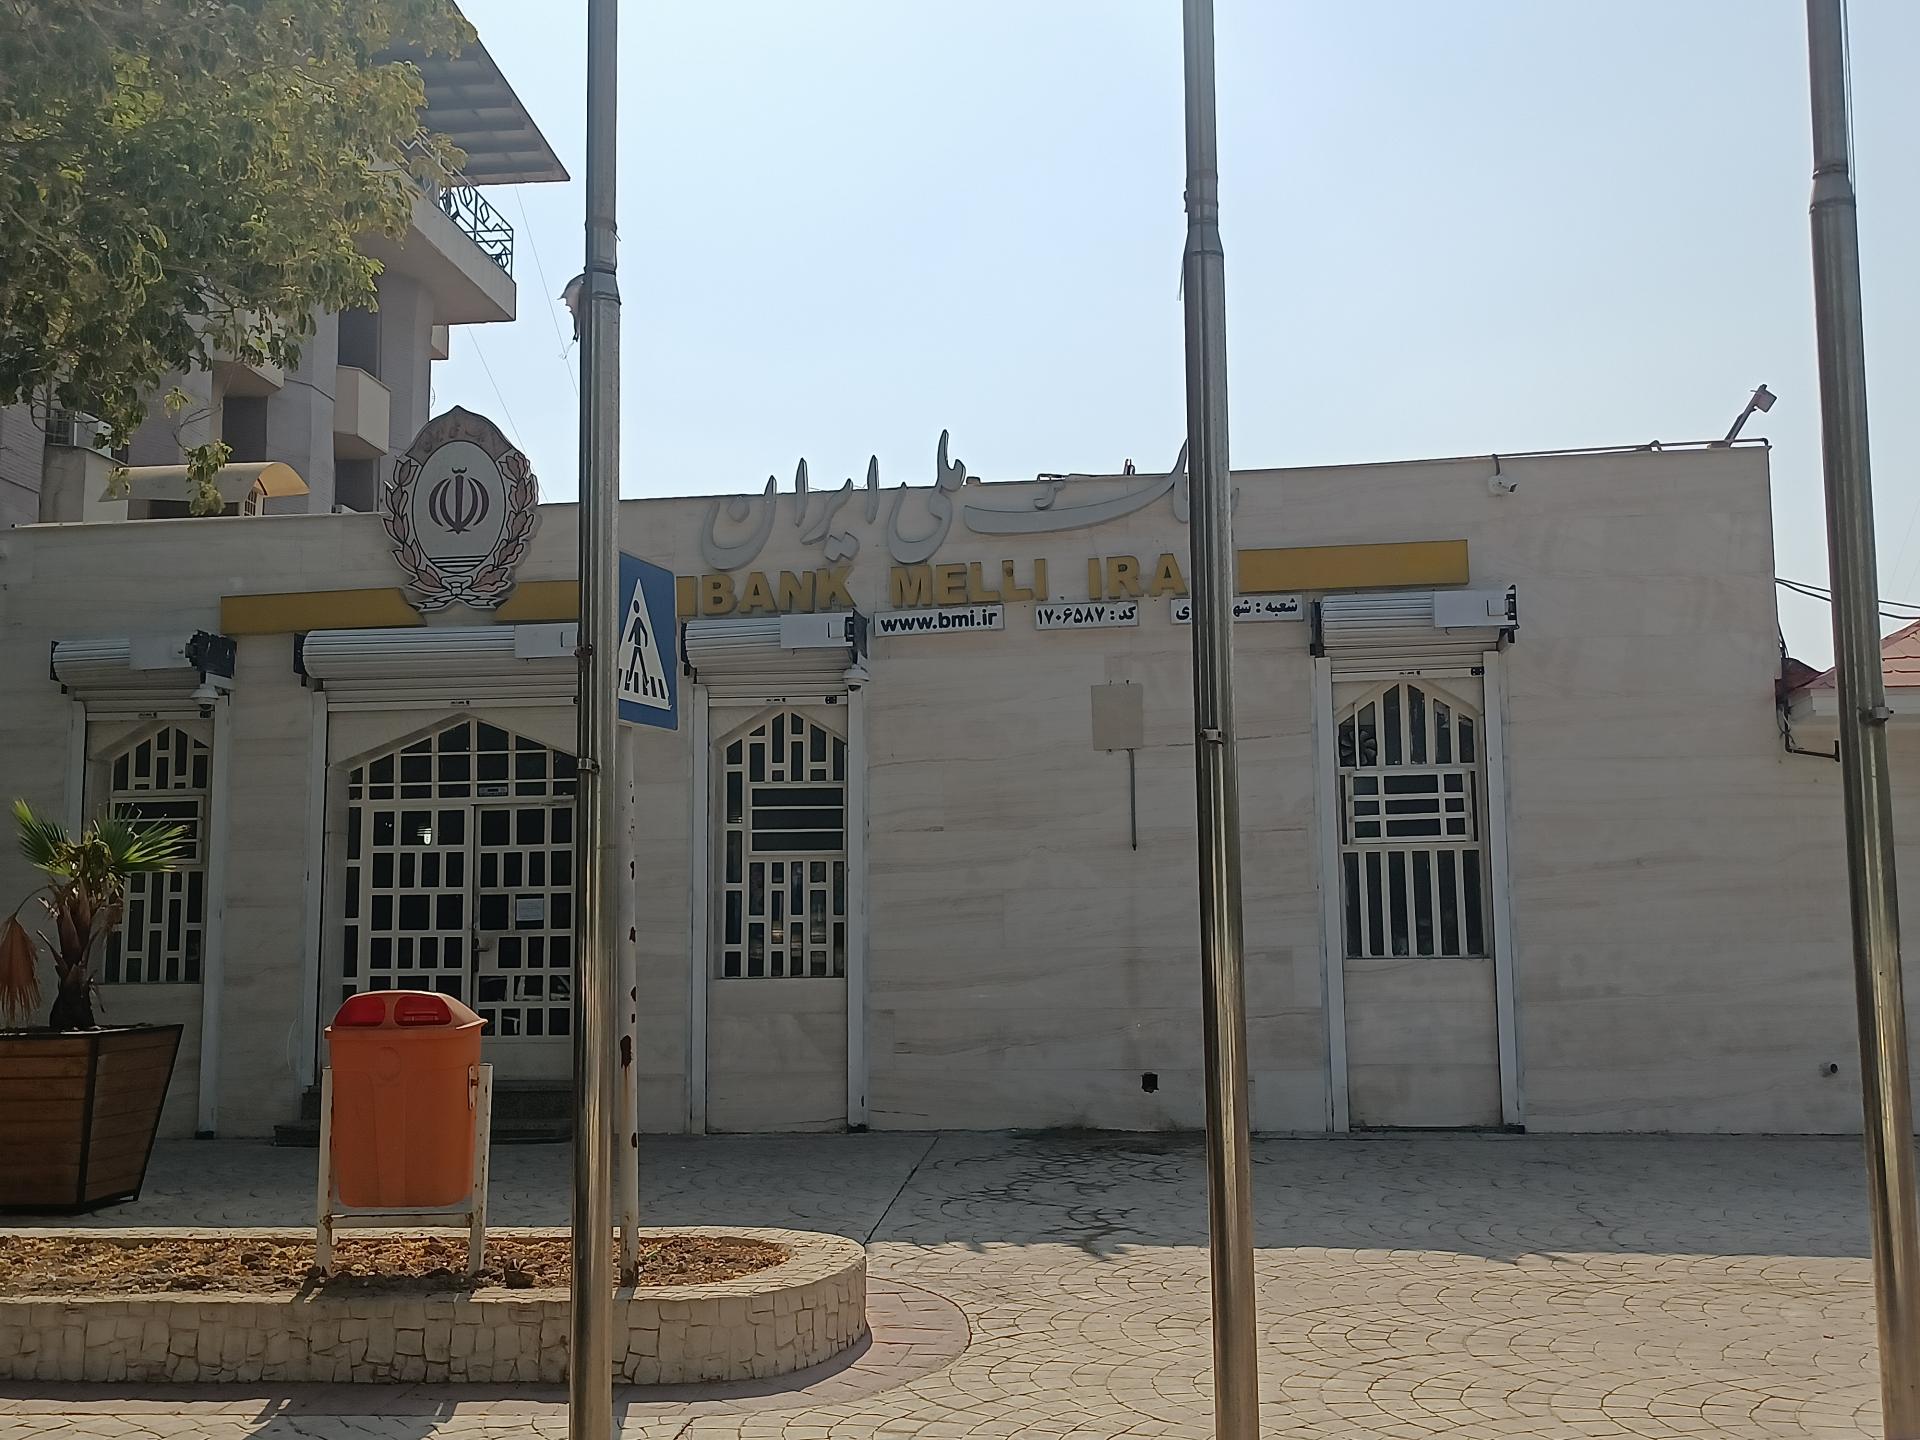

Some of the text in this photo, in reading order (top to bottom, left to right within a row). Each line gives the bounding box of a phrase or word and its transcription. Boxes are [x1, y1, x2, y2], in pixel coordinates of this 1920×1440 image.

[701, 455, 880, 570] ایران
[701, 553, 1189, 616] BANK MELLI IRA
[881, 609, 998, 633] www.bmi.ir
[1037, 606, 1106, 625] ۱۷۰۶۵۸۷
